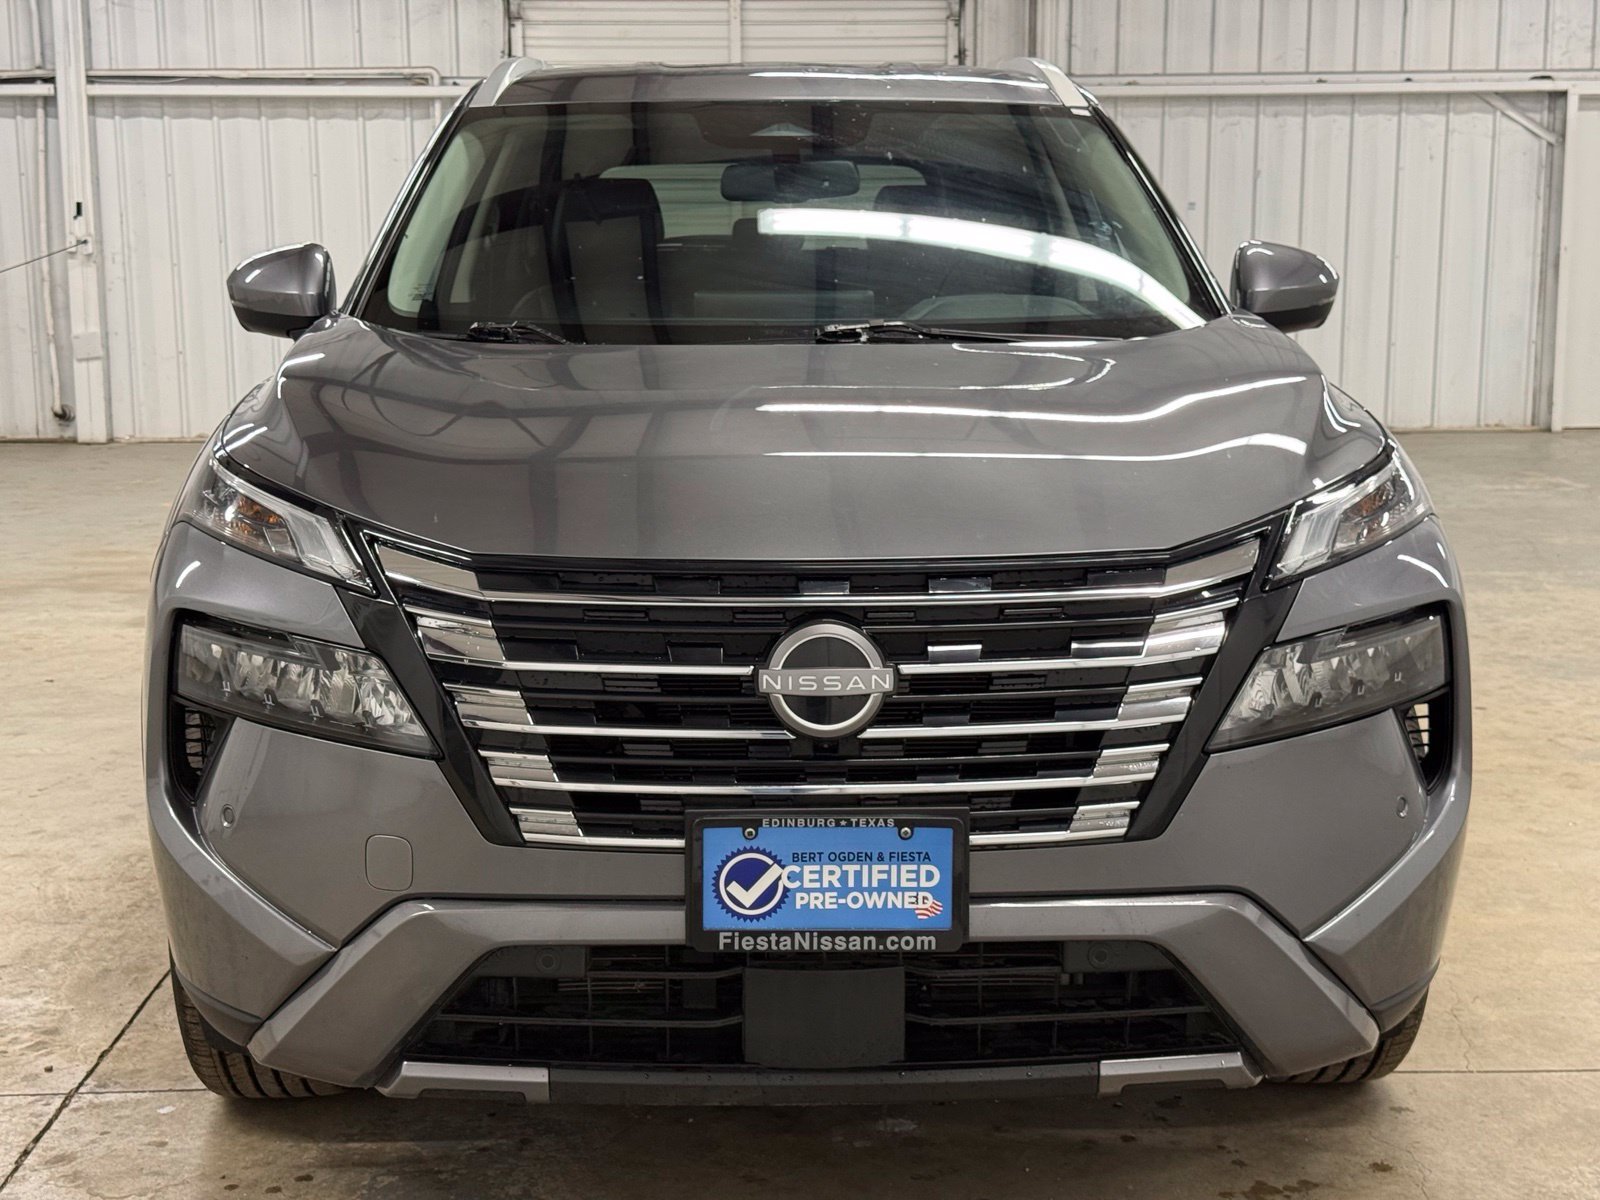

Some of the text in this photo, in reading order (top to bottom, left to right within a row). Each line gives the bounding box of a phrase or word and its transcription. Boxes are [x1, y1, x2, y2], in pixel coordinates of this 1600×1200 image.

[763, 674, 890, 690] NISSAN
[762, 819, 895, 828] EDINBURG TEXAS
[792, 852, 931, 862] BERT OGDEN & FIESTA
[781, 865, 940, 889] CERTIFIED
[795, 892, 933, 909] PRE-OWNED
[718, 932, 936, 951] FiestaNissan.com
